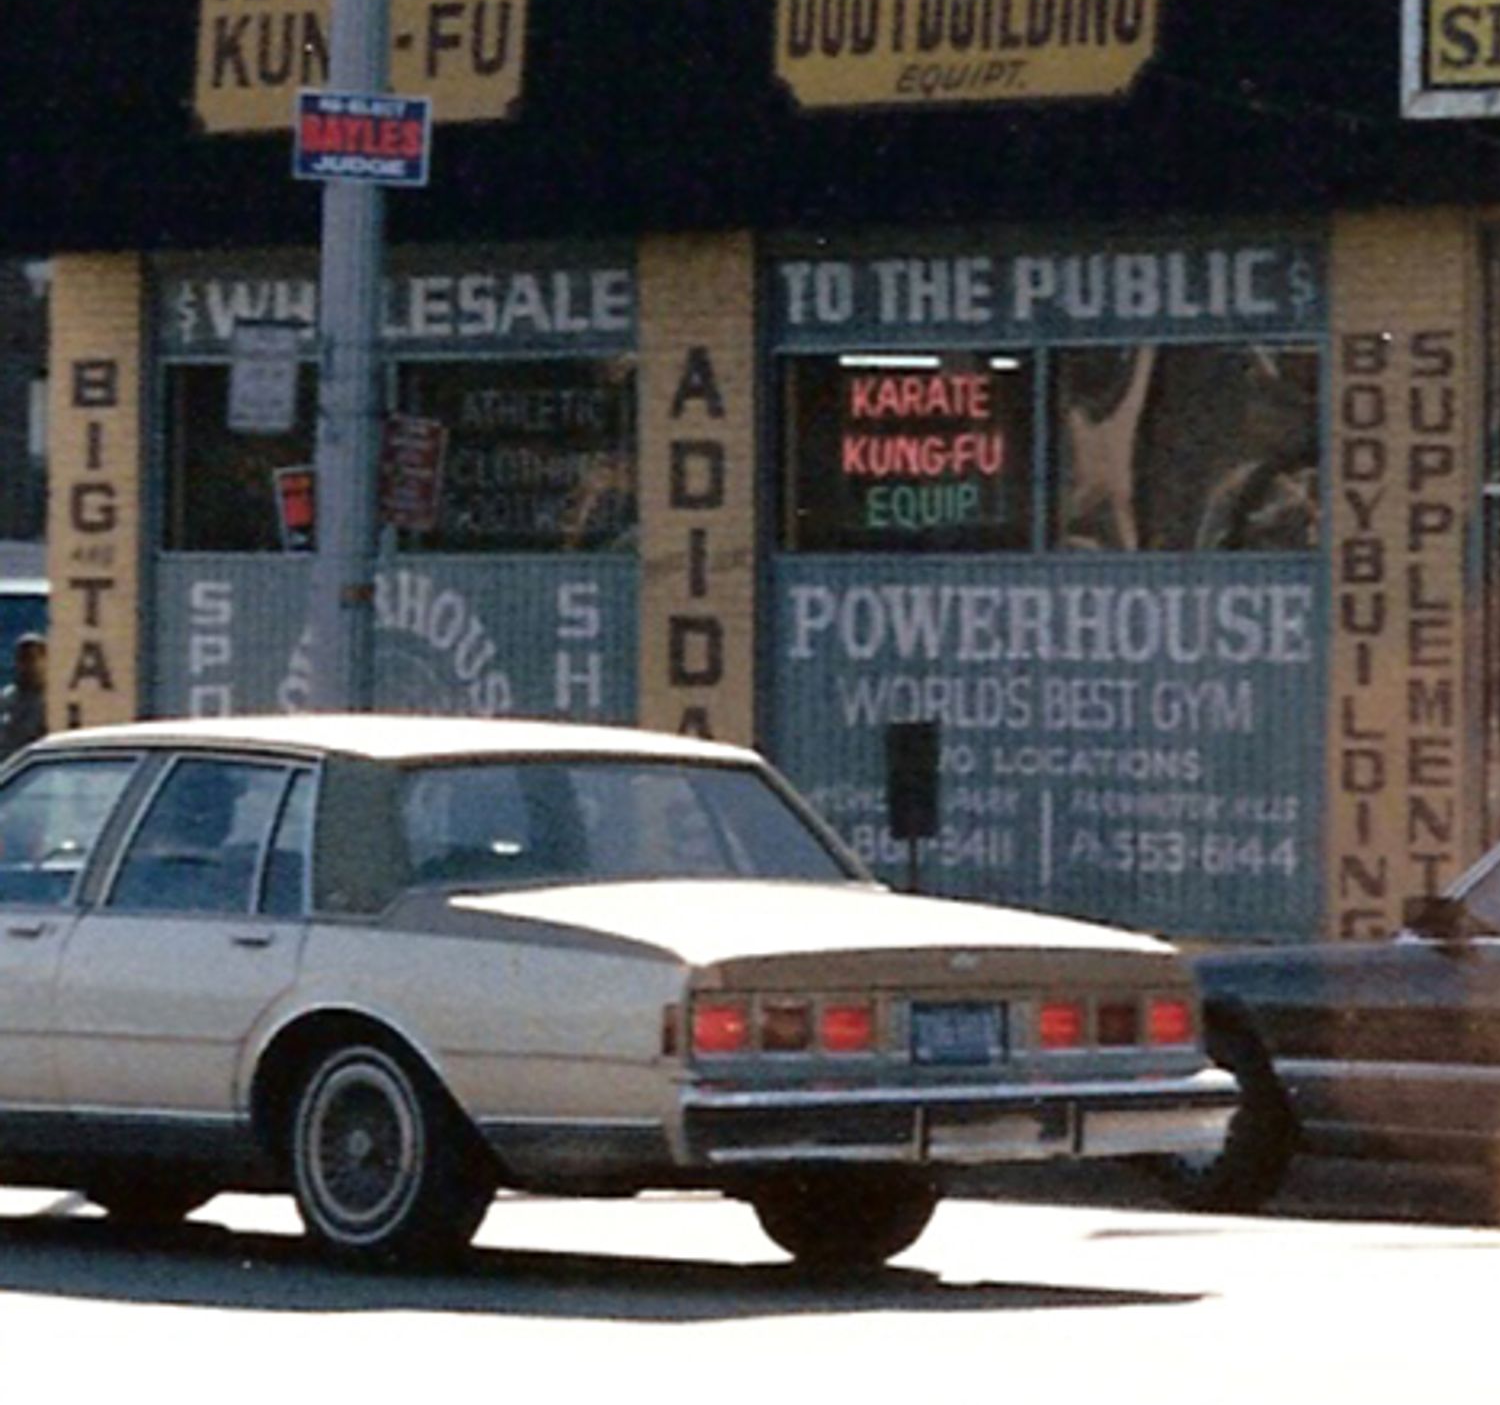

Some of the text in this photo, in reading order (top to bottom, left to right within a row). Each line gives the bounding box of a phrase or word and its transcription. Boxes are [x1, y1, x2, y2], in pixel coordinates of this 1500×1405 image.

[210, 1, 514, 89] KUN-FU
[896, 59, 1029, 97] EQUIPT.
[204, 270, 632, 340] WHLESALE
[779, 260, 853, 324] TO
[871, 257, 991, 323] THE
[1013, 250, 1278, 322] PUBLIC
[853, 373, 990, 419] KARATE
[71, 359, 119, 534] BIG
[865, 483, 979, 530] EQUIP
[789, 583, 1313, 664] POWERHOUSE
[1339, 331, 1388, 937] BODYBUILDING
[1043, 678, 1140, 732] BEST
[1152, 679, 1254, 734] GYM
[993, 746, 1202, 782] LOCATIONS
